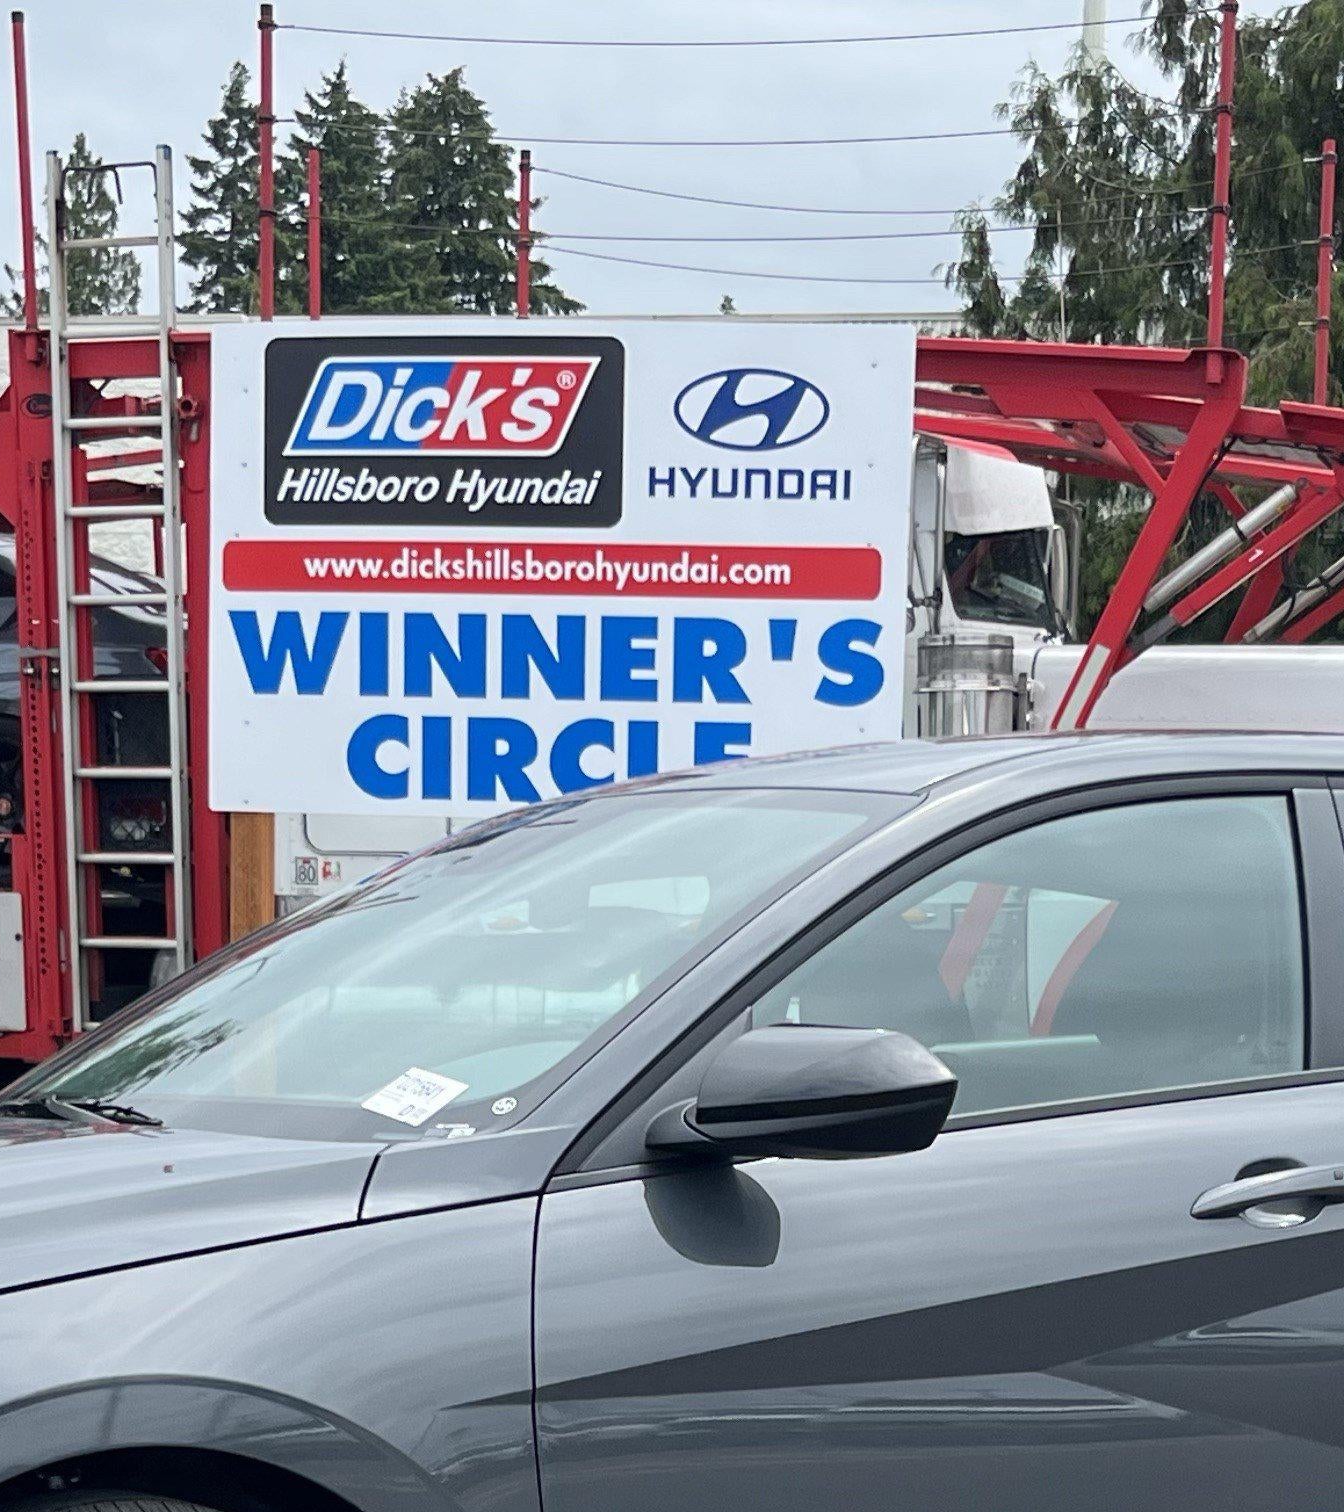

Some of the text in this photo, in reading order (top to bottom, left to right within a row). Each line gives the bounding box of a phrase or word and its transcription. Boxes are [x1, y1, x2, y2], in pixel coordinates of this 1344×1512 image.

[277, 467, 601, 512] Hillsboro Hyundai
[648, 466, 852, 501] HYUNDAI
[303, 548, 791, 591] www.dickshillsborohyundai.com
[229, 609, 885, 707] WINNER'S
